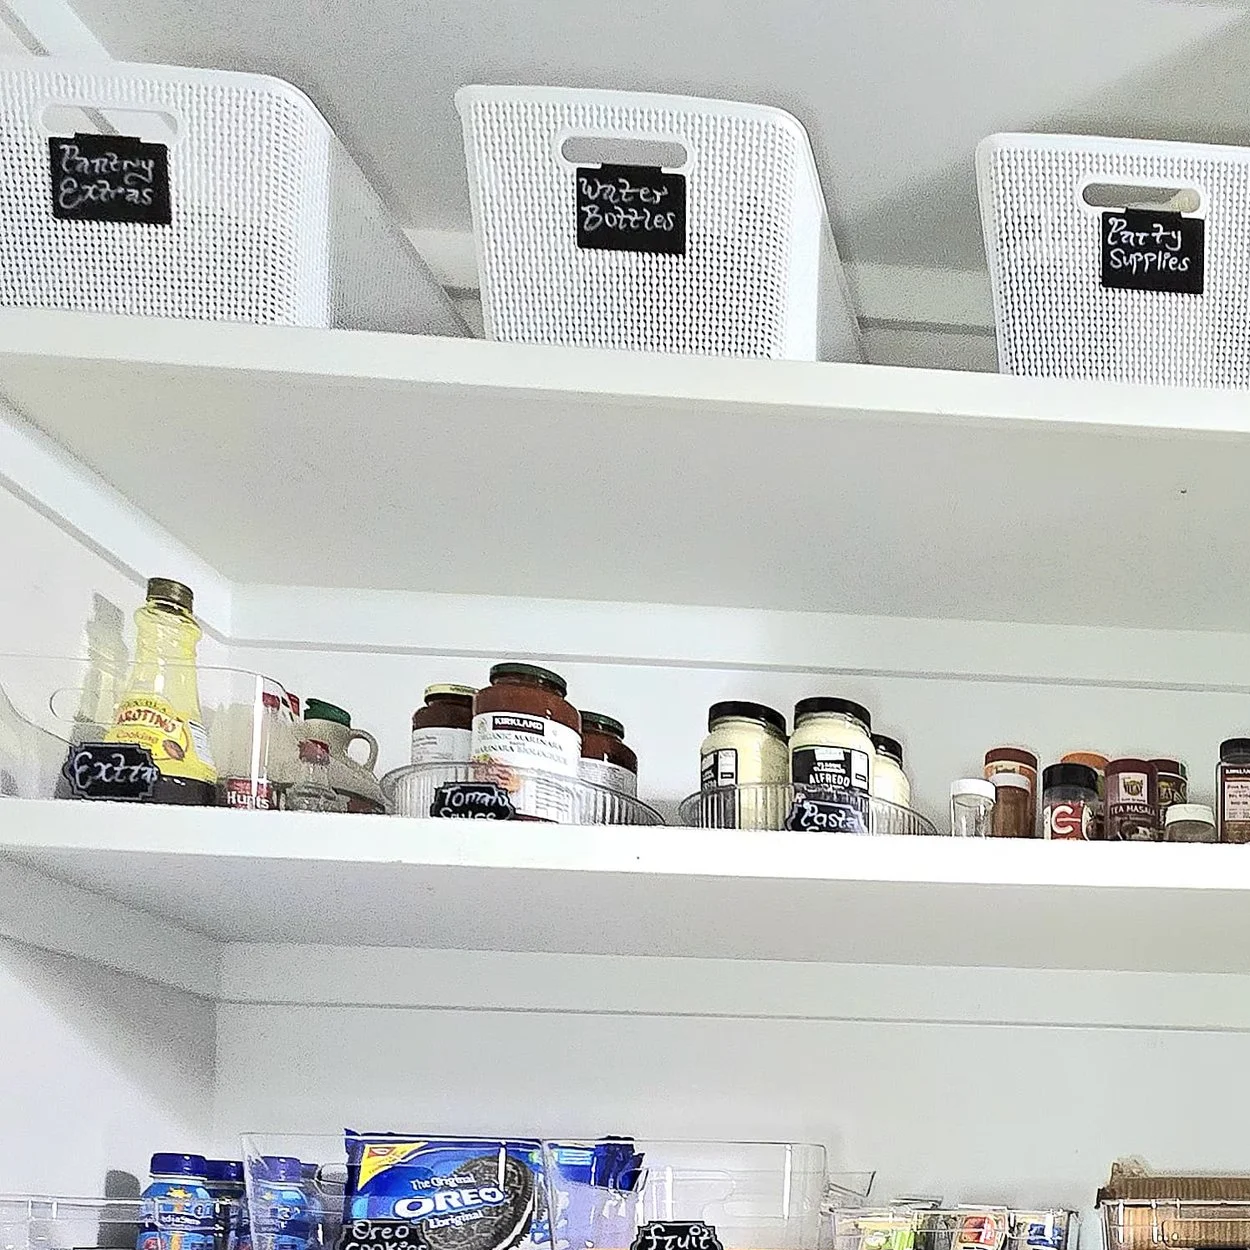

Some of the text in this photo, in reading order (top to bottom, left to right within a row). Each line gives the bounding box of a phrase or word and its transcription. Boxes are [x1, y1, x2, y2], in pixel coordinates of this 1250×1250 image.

[59, 177, 153, 210] Extras
[580, 177, 670, 204] Water
[580, 206, 676, 231] Bottles
[1107, 217, 1182, 251] Party
[1109, 249, 1191, 275] Supplies
[494, 717, 544, 730] KIRKLAND
[808, 773, 851, 788] ALFREDO
[1110, 806, 1124, 816] TEA
[1125, 804, 1157, 817] MASALA
[409, 1173, 476, 1193] The Original
[393, 1185, 507, 1220] OREO
[352, 1221, 410, 1242] Oreo
